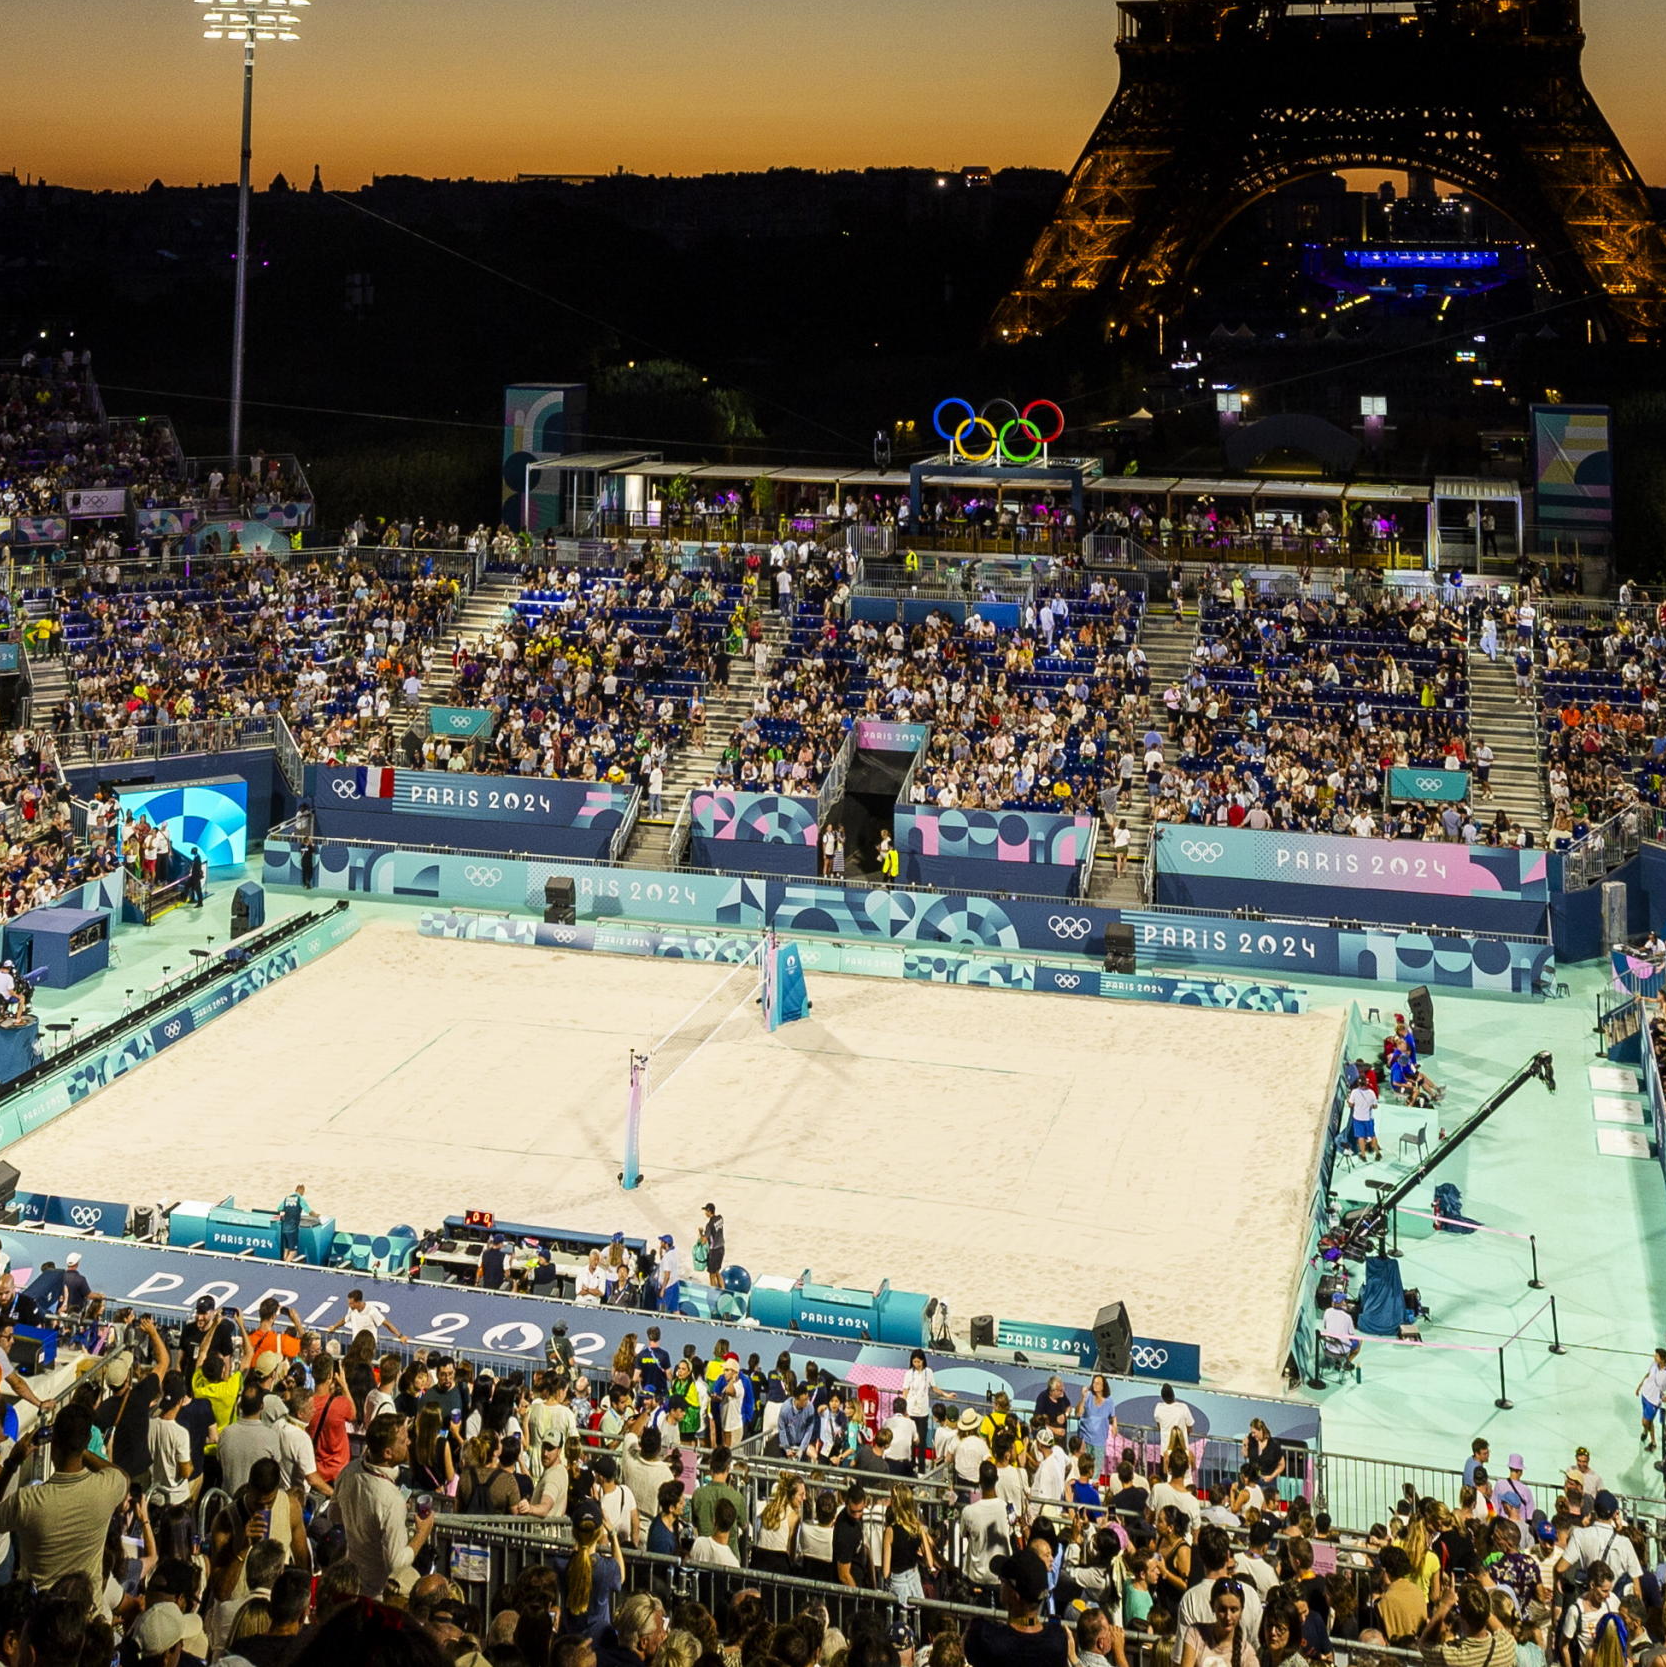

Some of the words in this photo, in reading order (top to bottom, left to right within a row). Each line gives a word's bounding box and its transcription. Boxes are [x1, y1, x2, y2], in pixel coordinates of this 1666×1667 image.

[863, 731, 892, 741] PARIS
[895, 733, 922, 742] 2024
[411, 785, 479, 807] PARIS
[488, 791, 550, 813] 2024
[1277, 849, 1359, 873] PARIS
[1371, 856, 1446, 879] 2024
[580, 877, 620, 897] RIS
[630, 882, 696, 905] 2024
[1143, 925, 1227, 951] PARIS
[1238, 933, 1316, 958] 2024
[1137, 983, 1163, 994] 2024
[214, 1233, 243, 1245] PARIS
[246, 1237, 273, 1249] 2024
[801, 1311, 835, 1325] PARIS
[837, 1316, 869, 1330] 2024
[1006, 1334, 1047, 1349] PARIS
[1052, 1338, 1090, 1354] 2024
